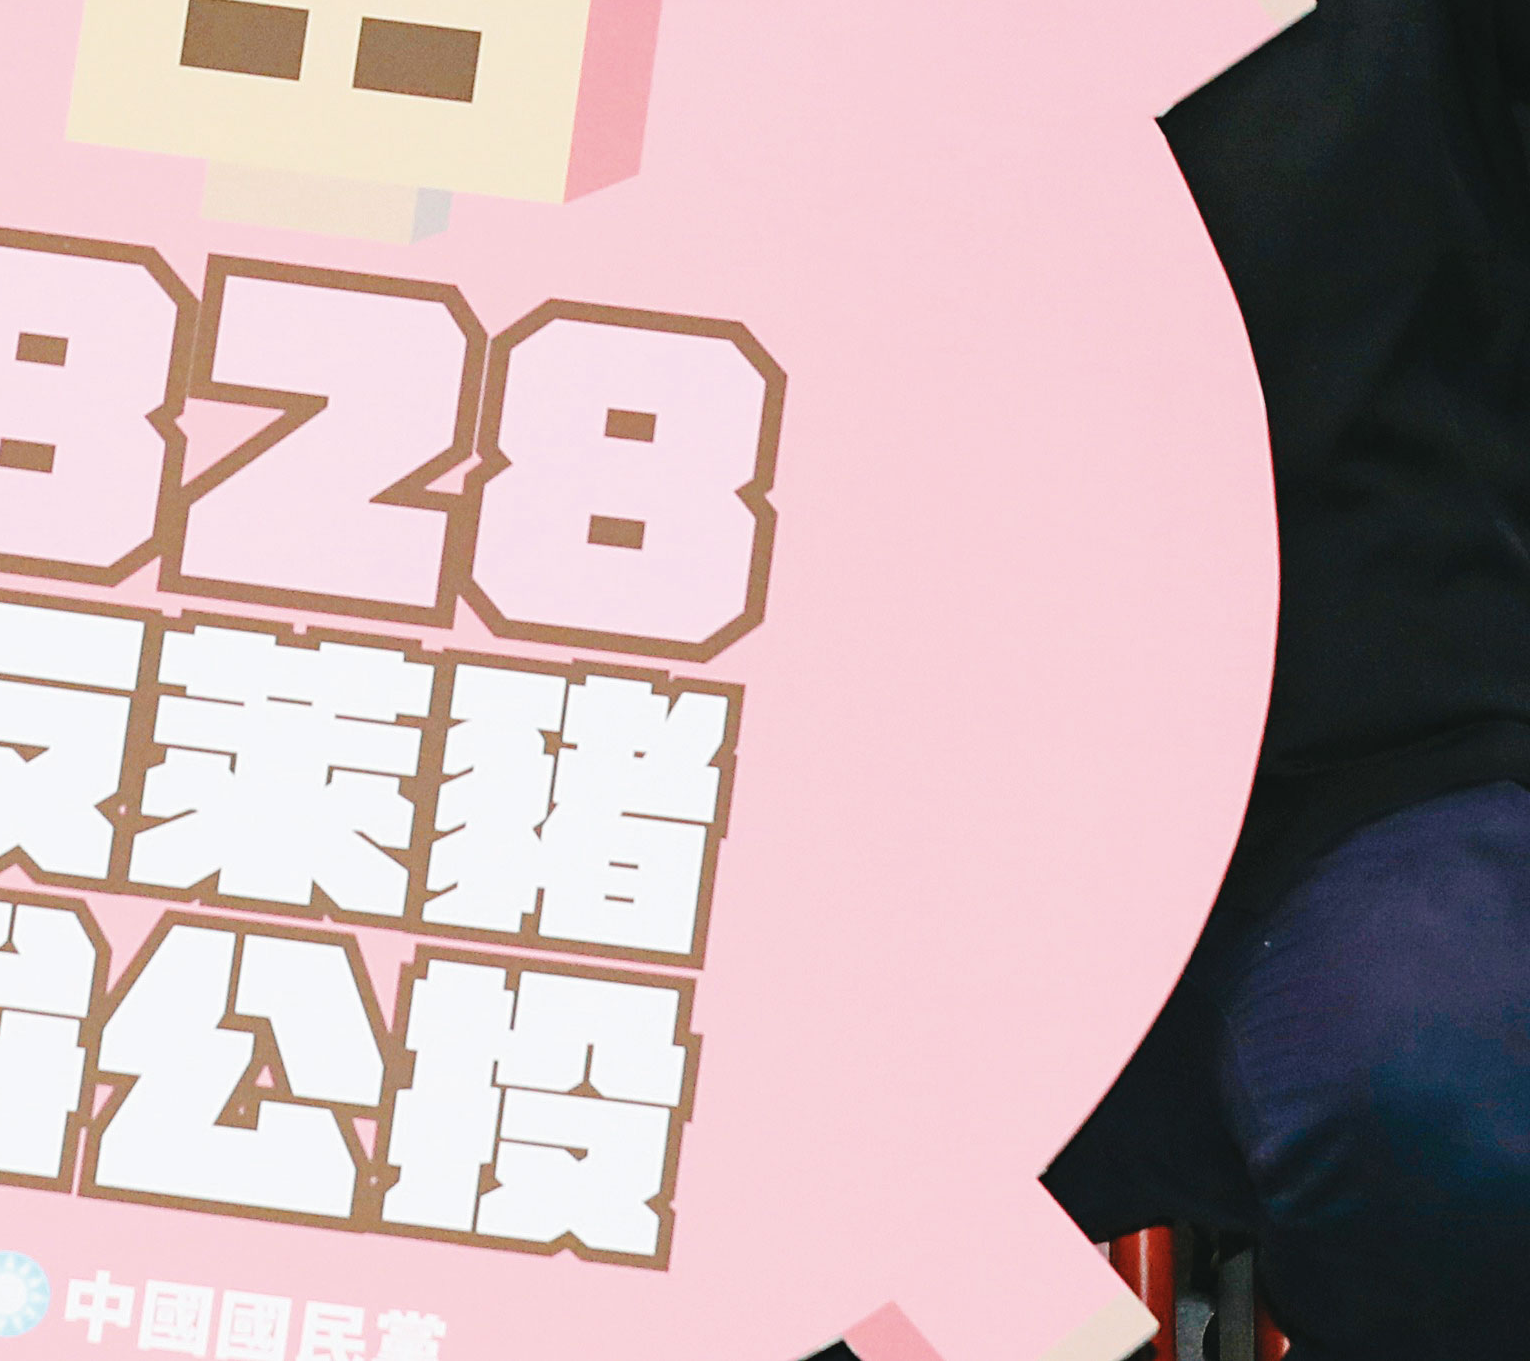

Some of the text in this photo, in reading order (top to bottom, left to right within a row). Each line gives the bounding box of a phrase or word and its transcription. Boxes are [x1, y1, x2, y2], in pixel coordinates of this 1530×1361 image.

[64, 1269, 447, 1361] 中國國民黨
